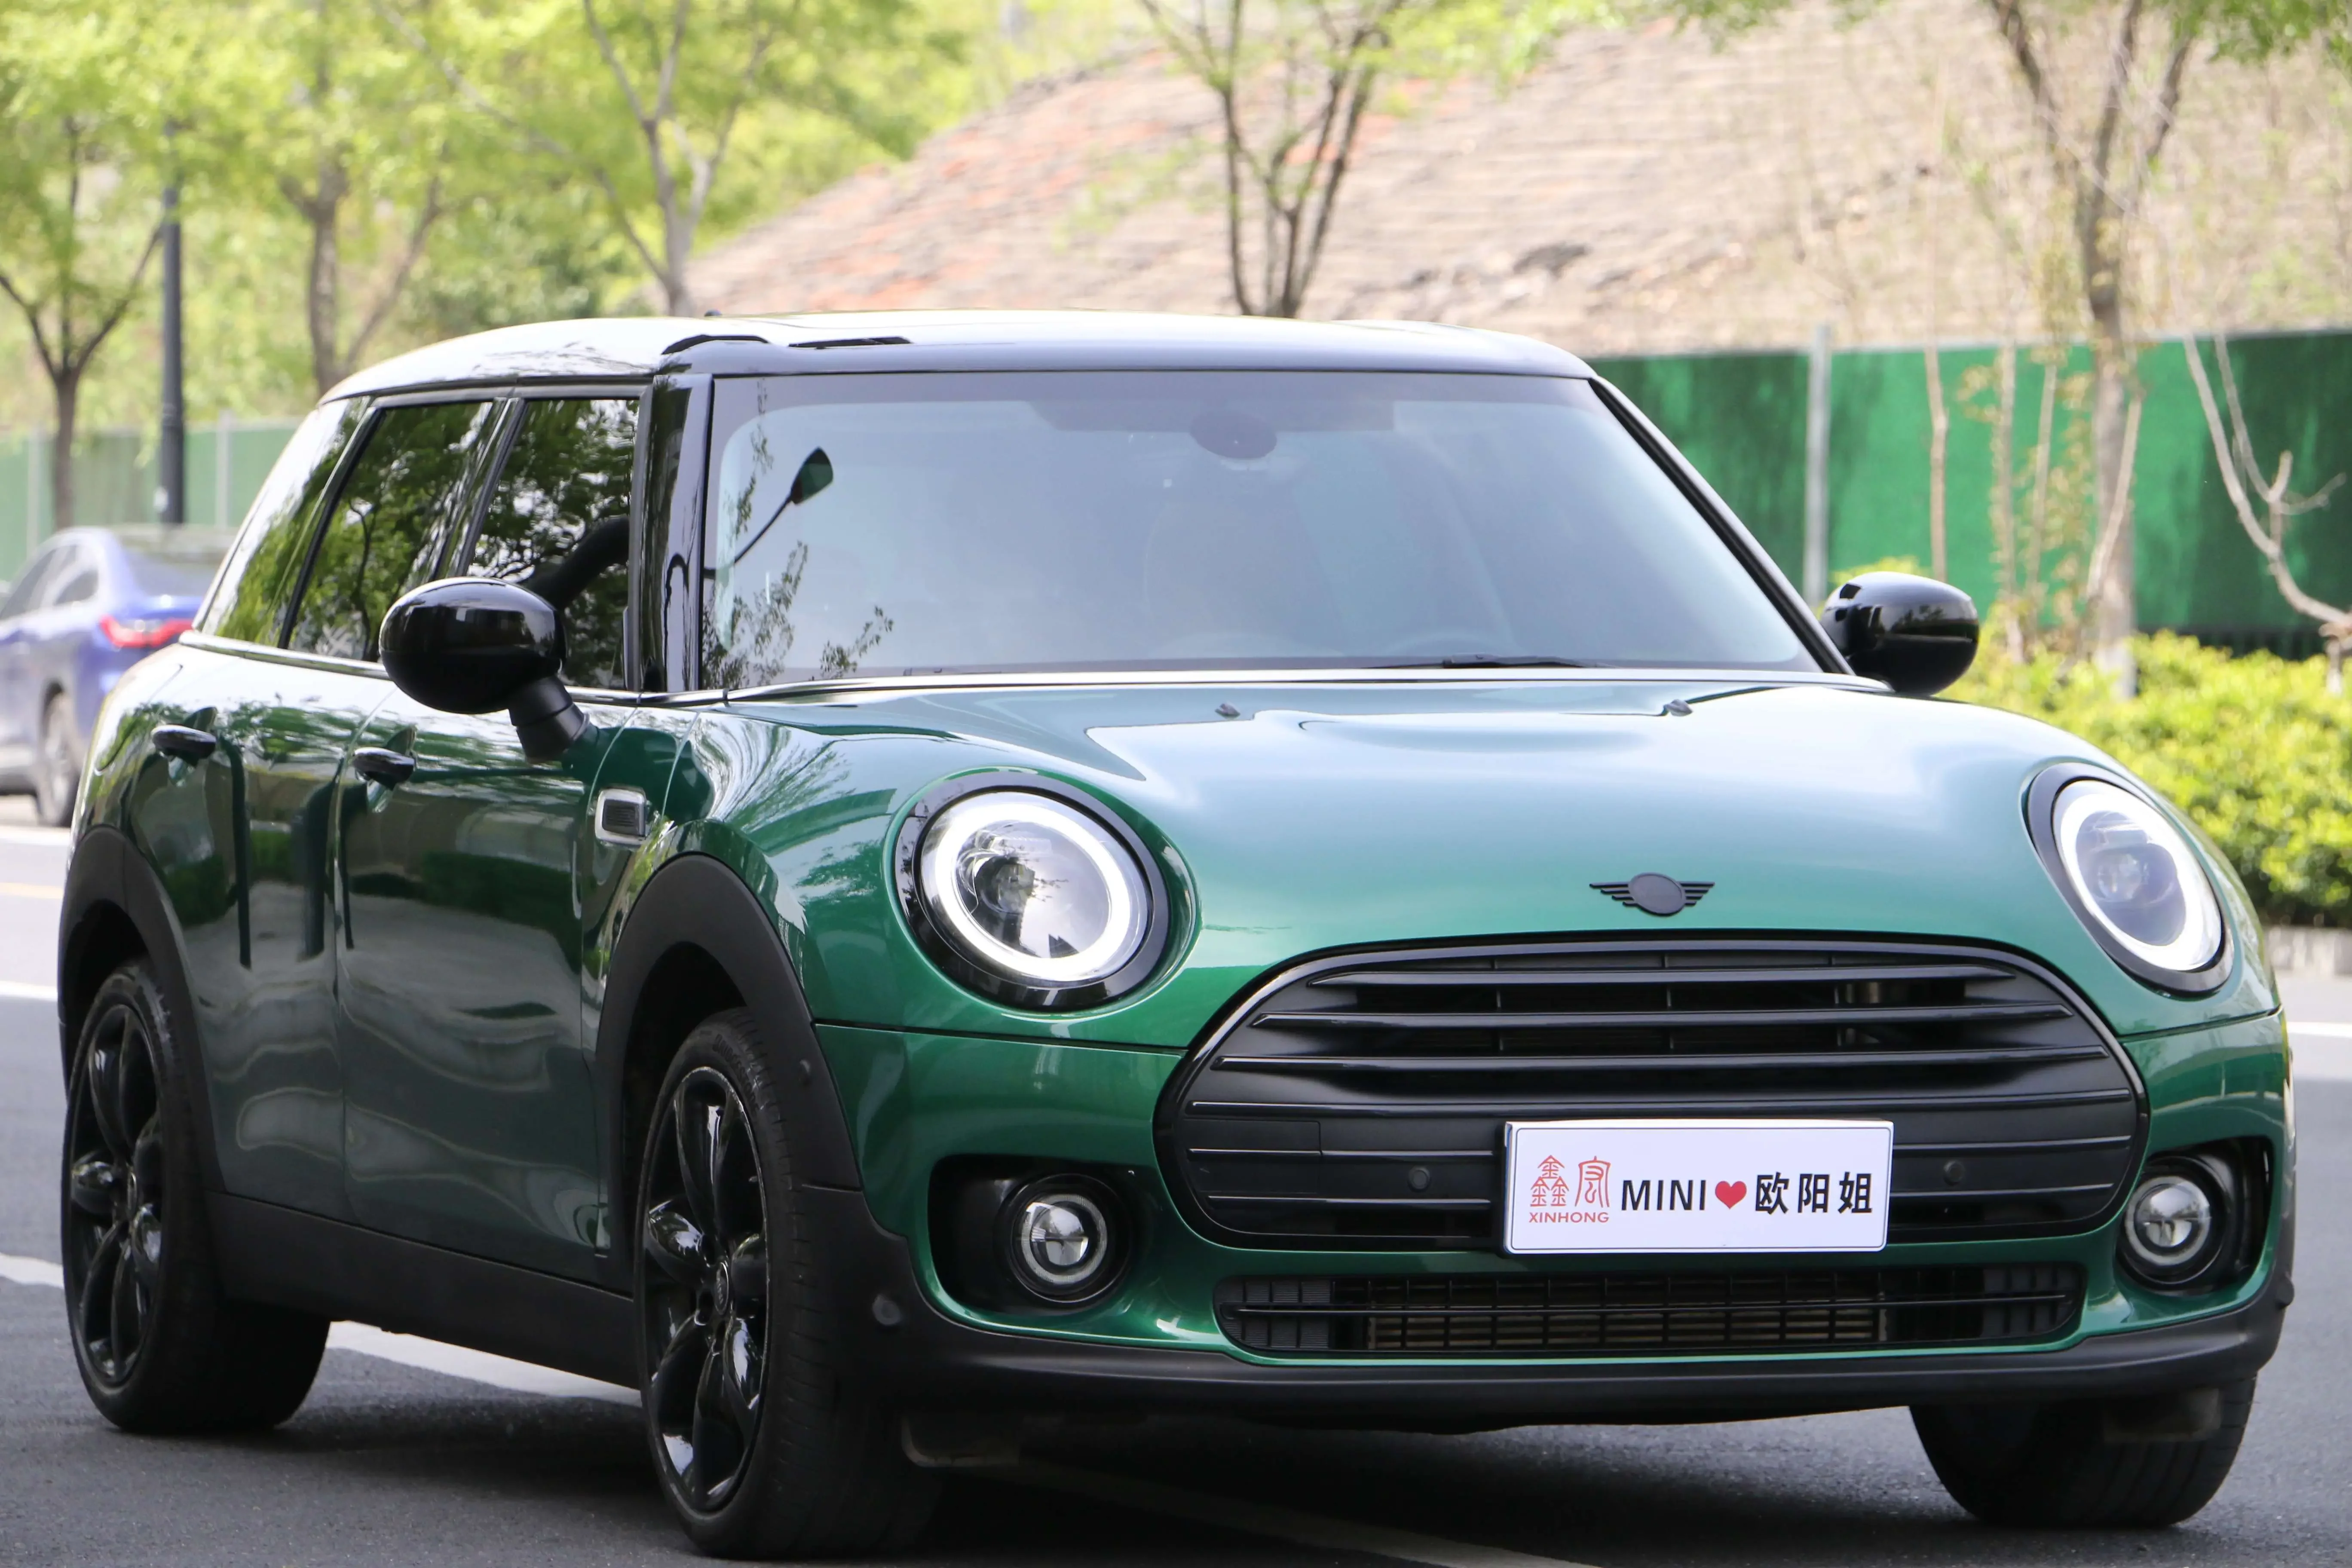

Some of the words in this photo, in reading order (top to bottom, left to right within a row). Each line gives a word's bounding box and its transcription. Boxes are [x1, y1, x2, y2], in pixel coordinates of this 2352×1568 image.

[1621, 1179, 1707, 1211] MINI
[1755, 1171, 1873, 1215] 欧阳姐
[1528, 1211, 1609, 1223] XINHONG
